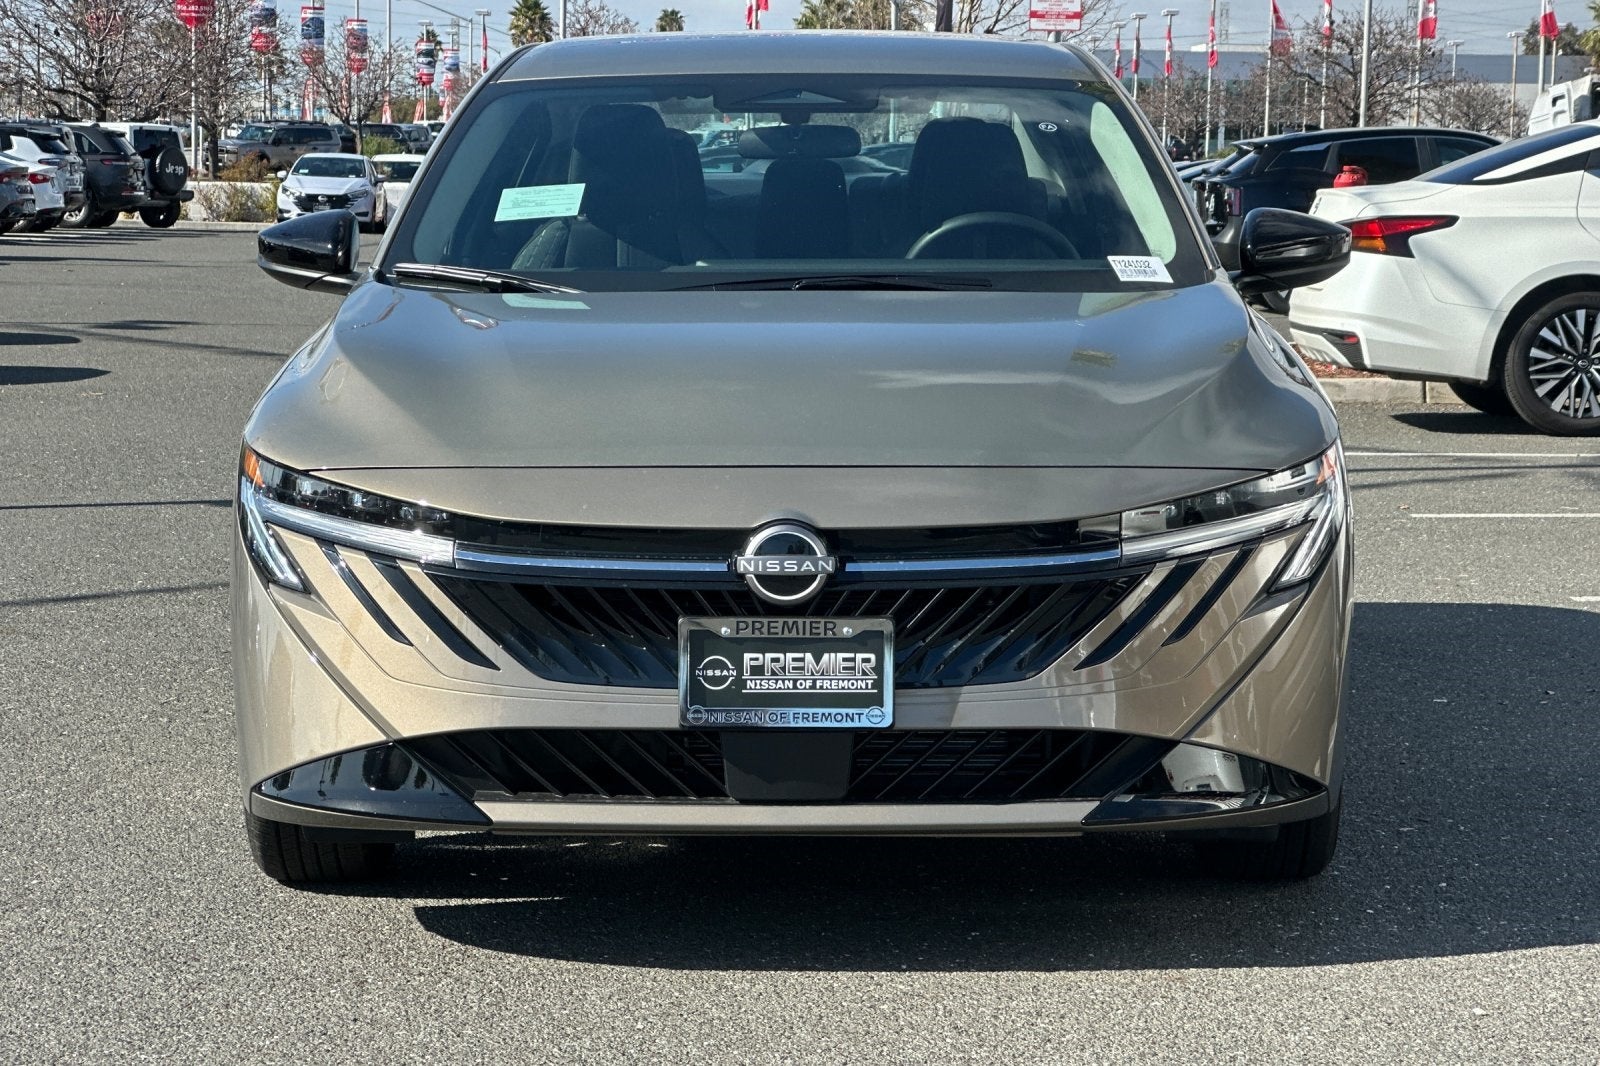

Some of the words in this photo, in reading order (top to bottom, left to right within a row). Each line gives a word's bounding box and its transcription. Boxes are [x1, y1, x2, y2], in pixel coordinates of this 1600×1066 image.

[165, 163, 184, 176] Jeep
[740, 560, 833, 572] NISSAN
[735, 620, 837, 637] PREMIER
[743, 652, 878, 676] PREMIER
[695, 669, 737, 677] NISSAN
[746, 679, 793, 690] NISSAN
[796, 679, 813, 690] OF
[816, 679, 874, 690] FREMONT
[708, 711, 764, 725] NISSAN
[767, 711, 788, 725] OF
[793, 711, 865, 725] FREMONT
